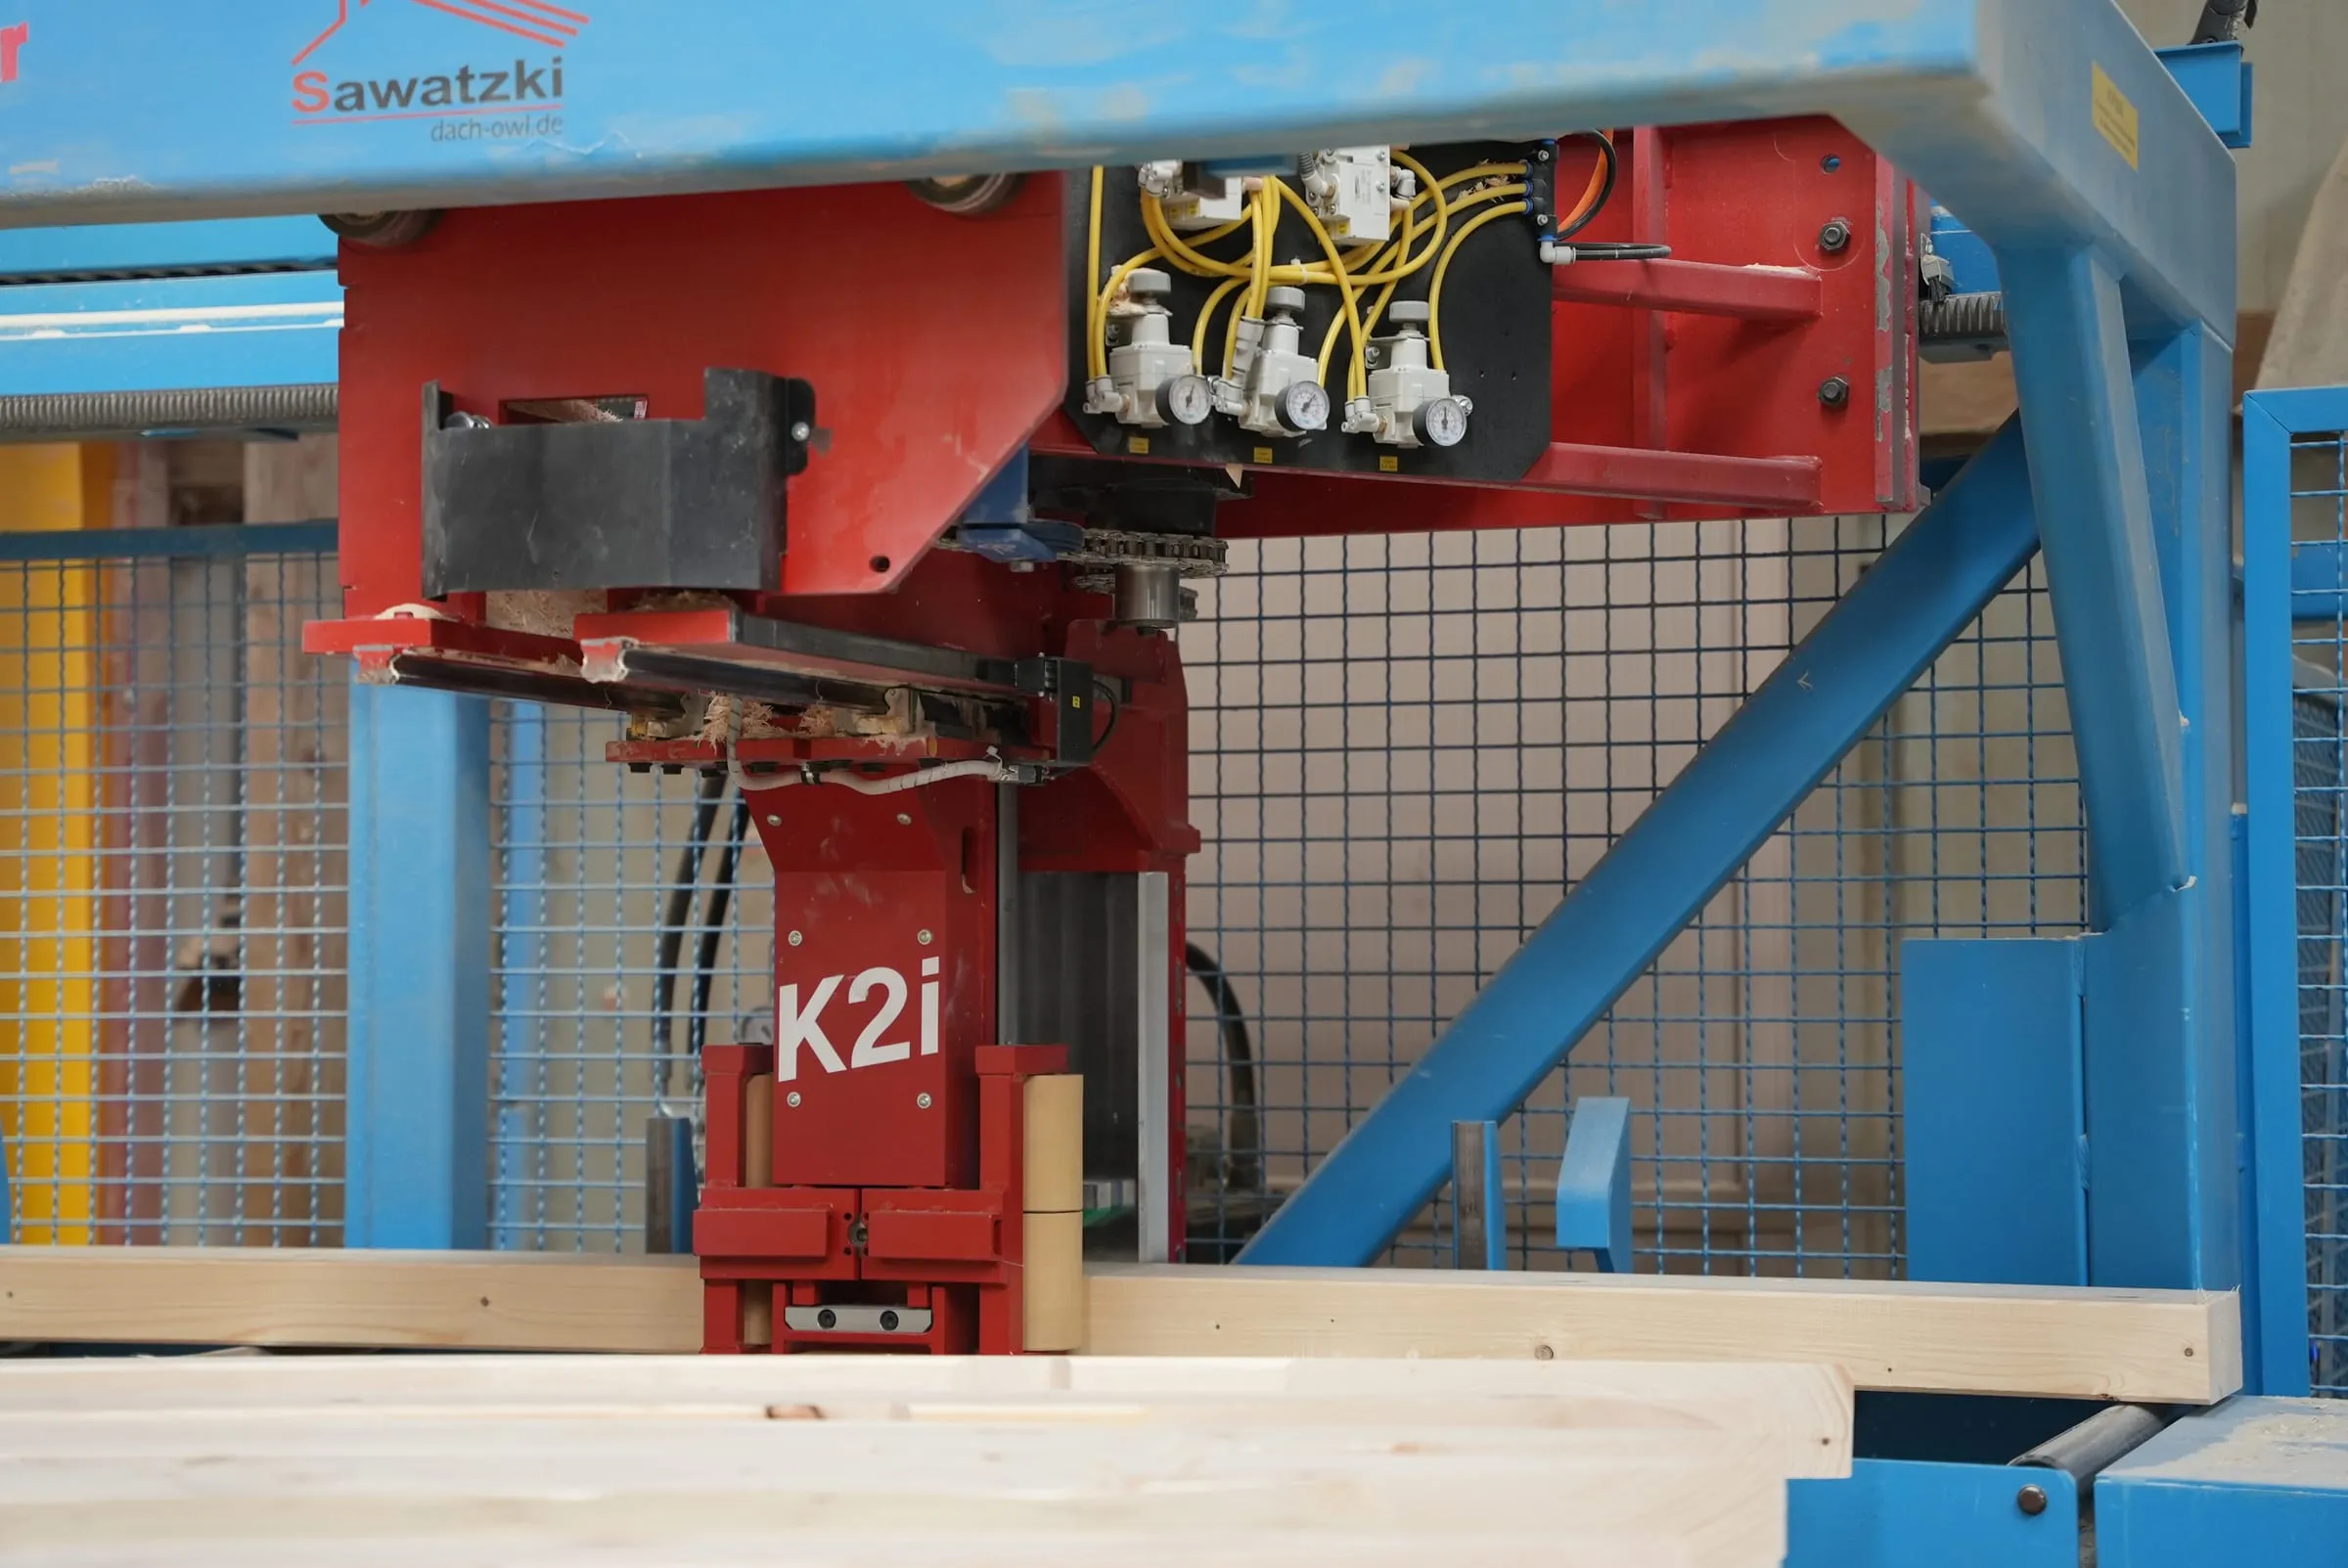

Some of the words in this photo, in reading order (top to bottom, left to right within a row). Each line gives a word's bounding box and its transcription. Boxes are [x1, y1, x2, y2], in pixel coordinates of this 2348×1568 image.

[292, 56, 563, 113] Sawatzki
[430, 113, 564, 143] dach-owl.de
[778, 956, 940, 1083] K2i
